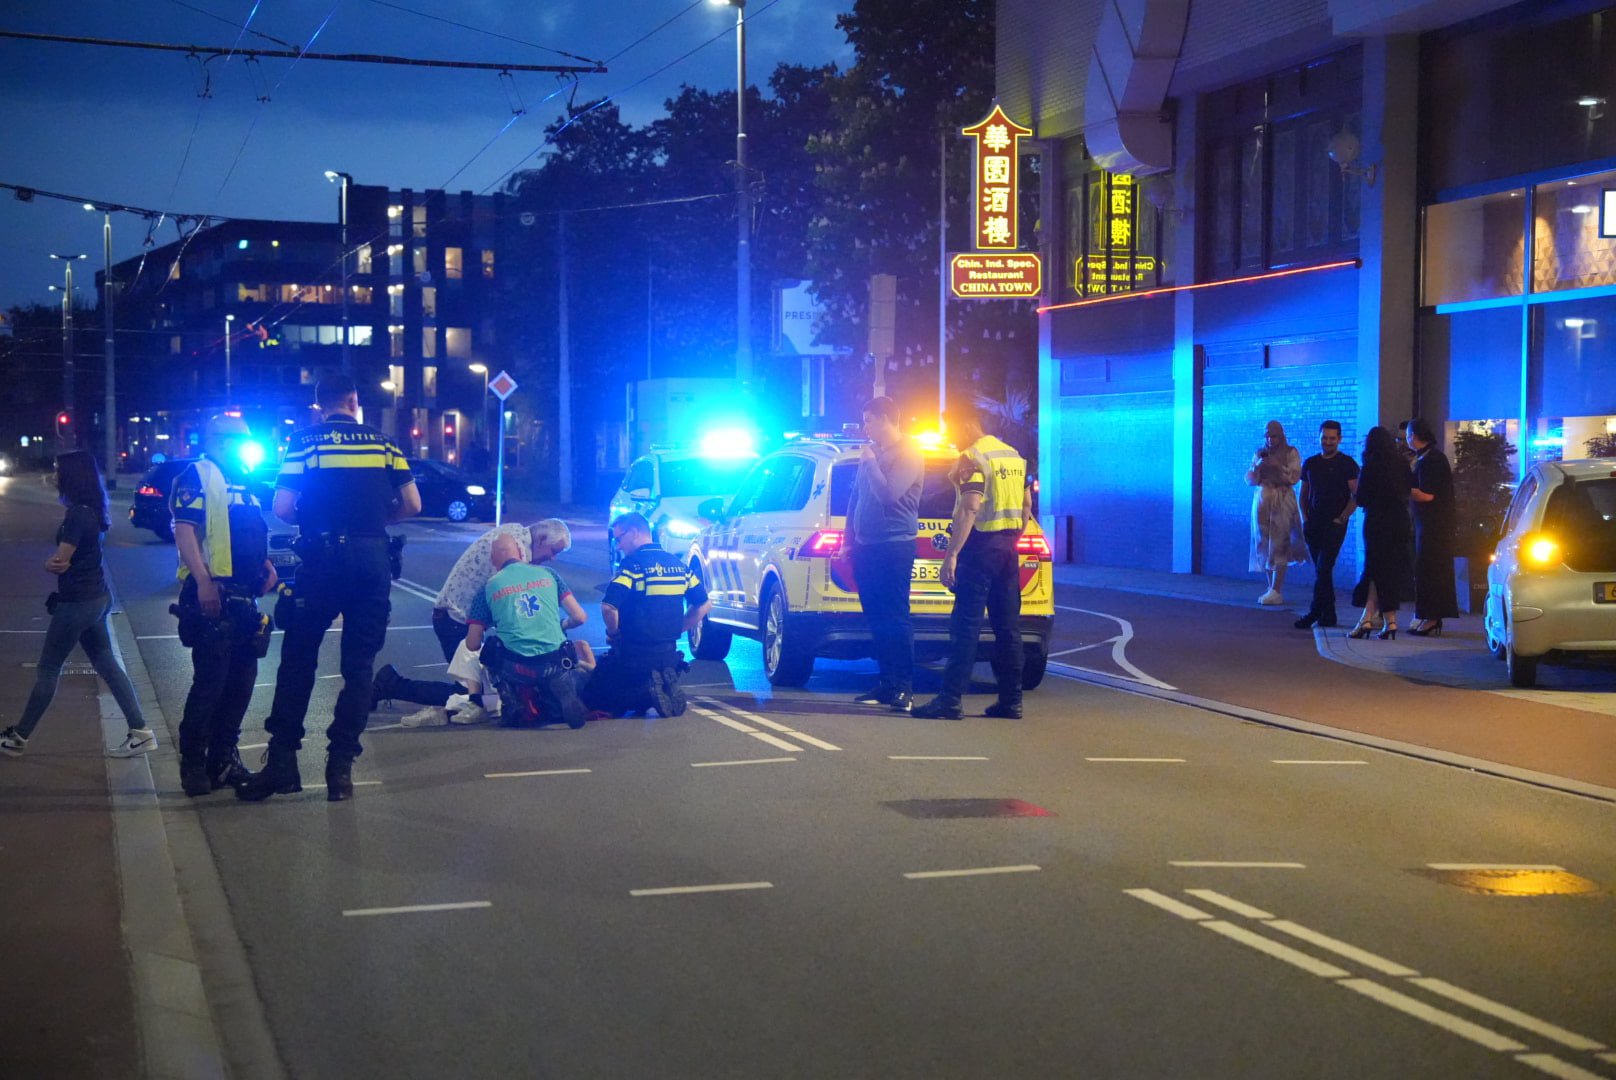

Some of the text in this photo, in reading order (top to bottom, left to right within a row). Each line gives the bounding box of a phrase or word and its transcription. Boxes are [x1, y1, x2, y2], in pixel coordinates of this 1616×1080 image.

[957, 259, 1035, 269] Chin. Ind. Spec.
[968, 270, 1024, 279] Restaurant
[960, 282, 1032, 293] CHINA TOWN
